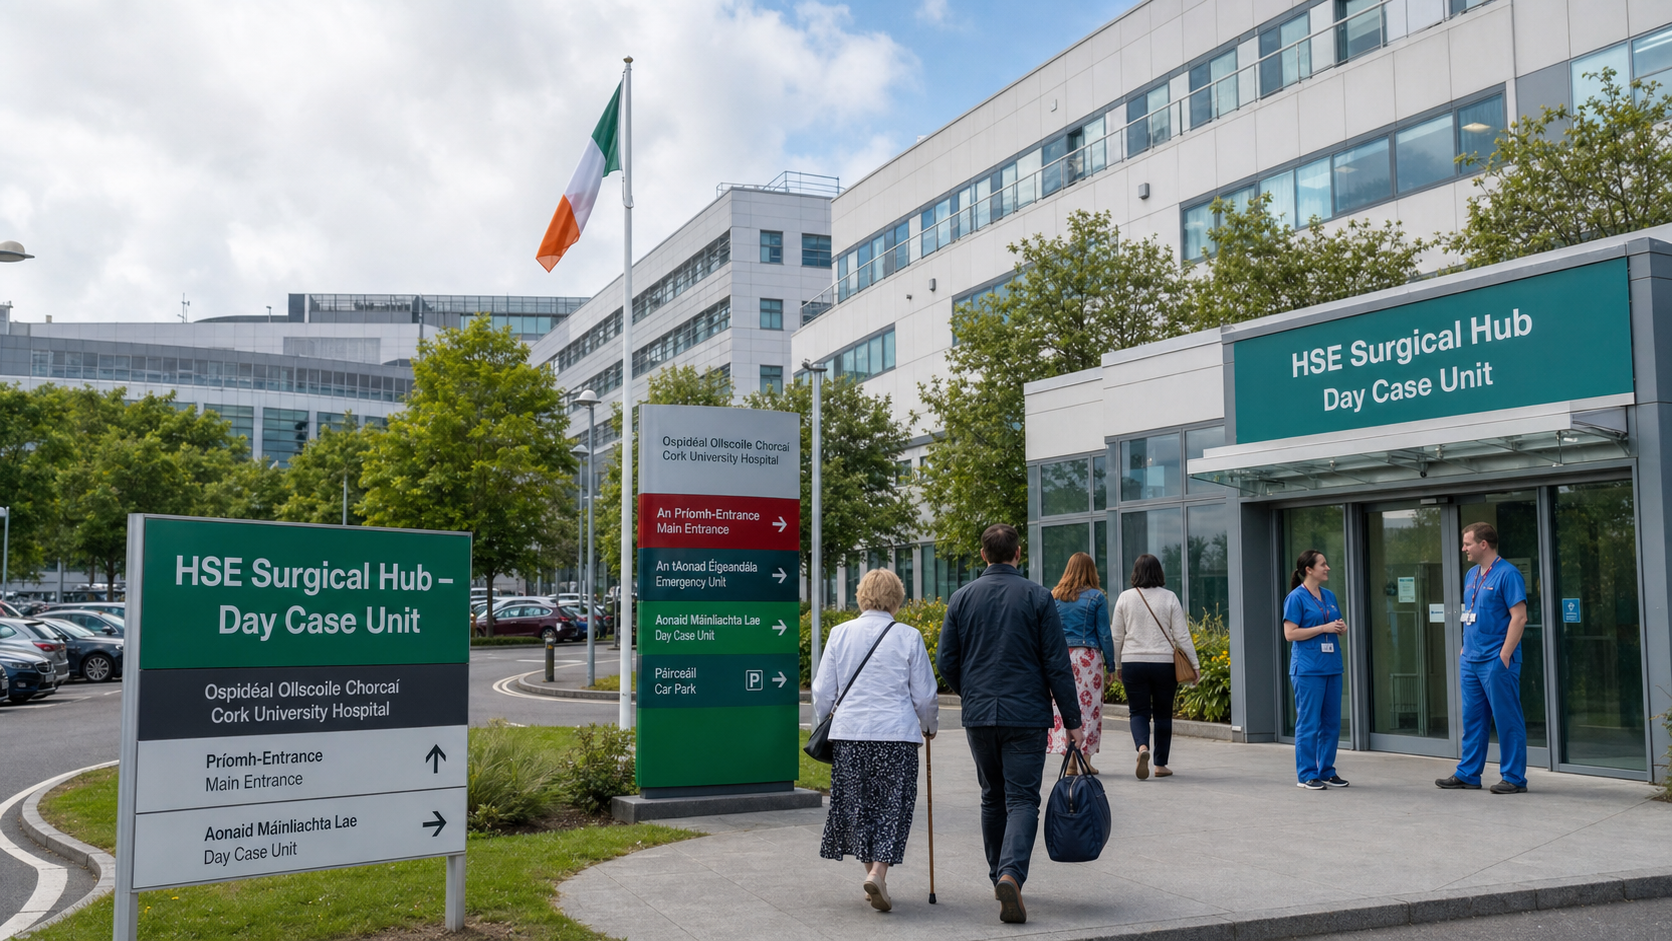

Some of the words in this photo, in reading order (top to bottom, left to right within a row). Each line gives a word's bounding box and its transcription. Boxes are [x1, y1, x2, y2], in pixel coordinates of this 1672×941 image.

[1292, 345, 1342, 377] HSE
[1350, 320, 1461, 368] Surgical
[1470, 309, 1532, 344] Hub
[1323, 388, 1365, 412] Day
[1372, 378, 1432, 403] Case
[1439, 362, 1493, 392] Unit
[662, 436, 707, 448] Ospidéal
[710, 438, 752, 449] Ollscoile
[662, 450, 686, 460] Cork
[689, 452, 738, 465] University
[740, 454, 778, 466] Hospital
[656, 508, 671, 518] An
[674, 508, 759, 520] Príomh-Entrance
[657, 523, 681, 533] Main
[684, 523, 729, 534] Entrance
[655, 561, 669, 571] An
[671, 561, 706, 571] tAonad
[708, 559, 757, 574] Éigeandála
[175, 555, 242, 586] HSE
[251, 558, 369, 595] Surgical
[379, 563, 432, 591] Hub
[655, 576, 706, 589] Emergency
[708, 576, 726, 587] Unit
[219, 605, 277, 641] Day
[284, 606, 356, 634] Case
[366, 607, 420, 633] Unit
[655, 615, 687, 626] Aonaid
[744, 615, 760, 626] Lae
[655, 630, 671, 644] Day
[673, 630, 695, 641] Case
[696, 630, 714, 641] Unit
[655, 668, 696, 678] Páirceáil
[749, 673, 759, 687] P
[204, 683, 273, 703] Ospidéal
[278, 681, 340, 697] Ollscoile
[345, 679, 399, 695] Chorcaí
[654, 684, 672, 694] Car
[674, 683, 696, 694] Park
[211, 707, 249, 723] Cork
[254, 705, 328, 722] University
[332, 701, 389, 720] Hospital
[206, 751, 322, 768] Príomh-Entrance
[205, 776, 239, 791] Main
[244, 775, 302, 789] Entrance
[204, 823, 253, 841] Aonaid
[257, 818, 331, 836] Máinliachta
[335, 815, 357, 828] Lae
[204, 850, 230, 866] Day
[234, 847, 267, 861] Case
[271, 842, 297, 857] Unit
